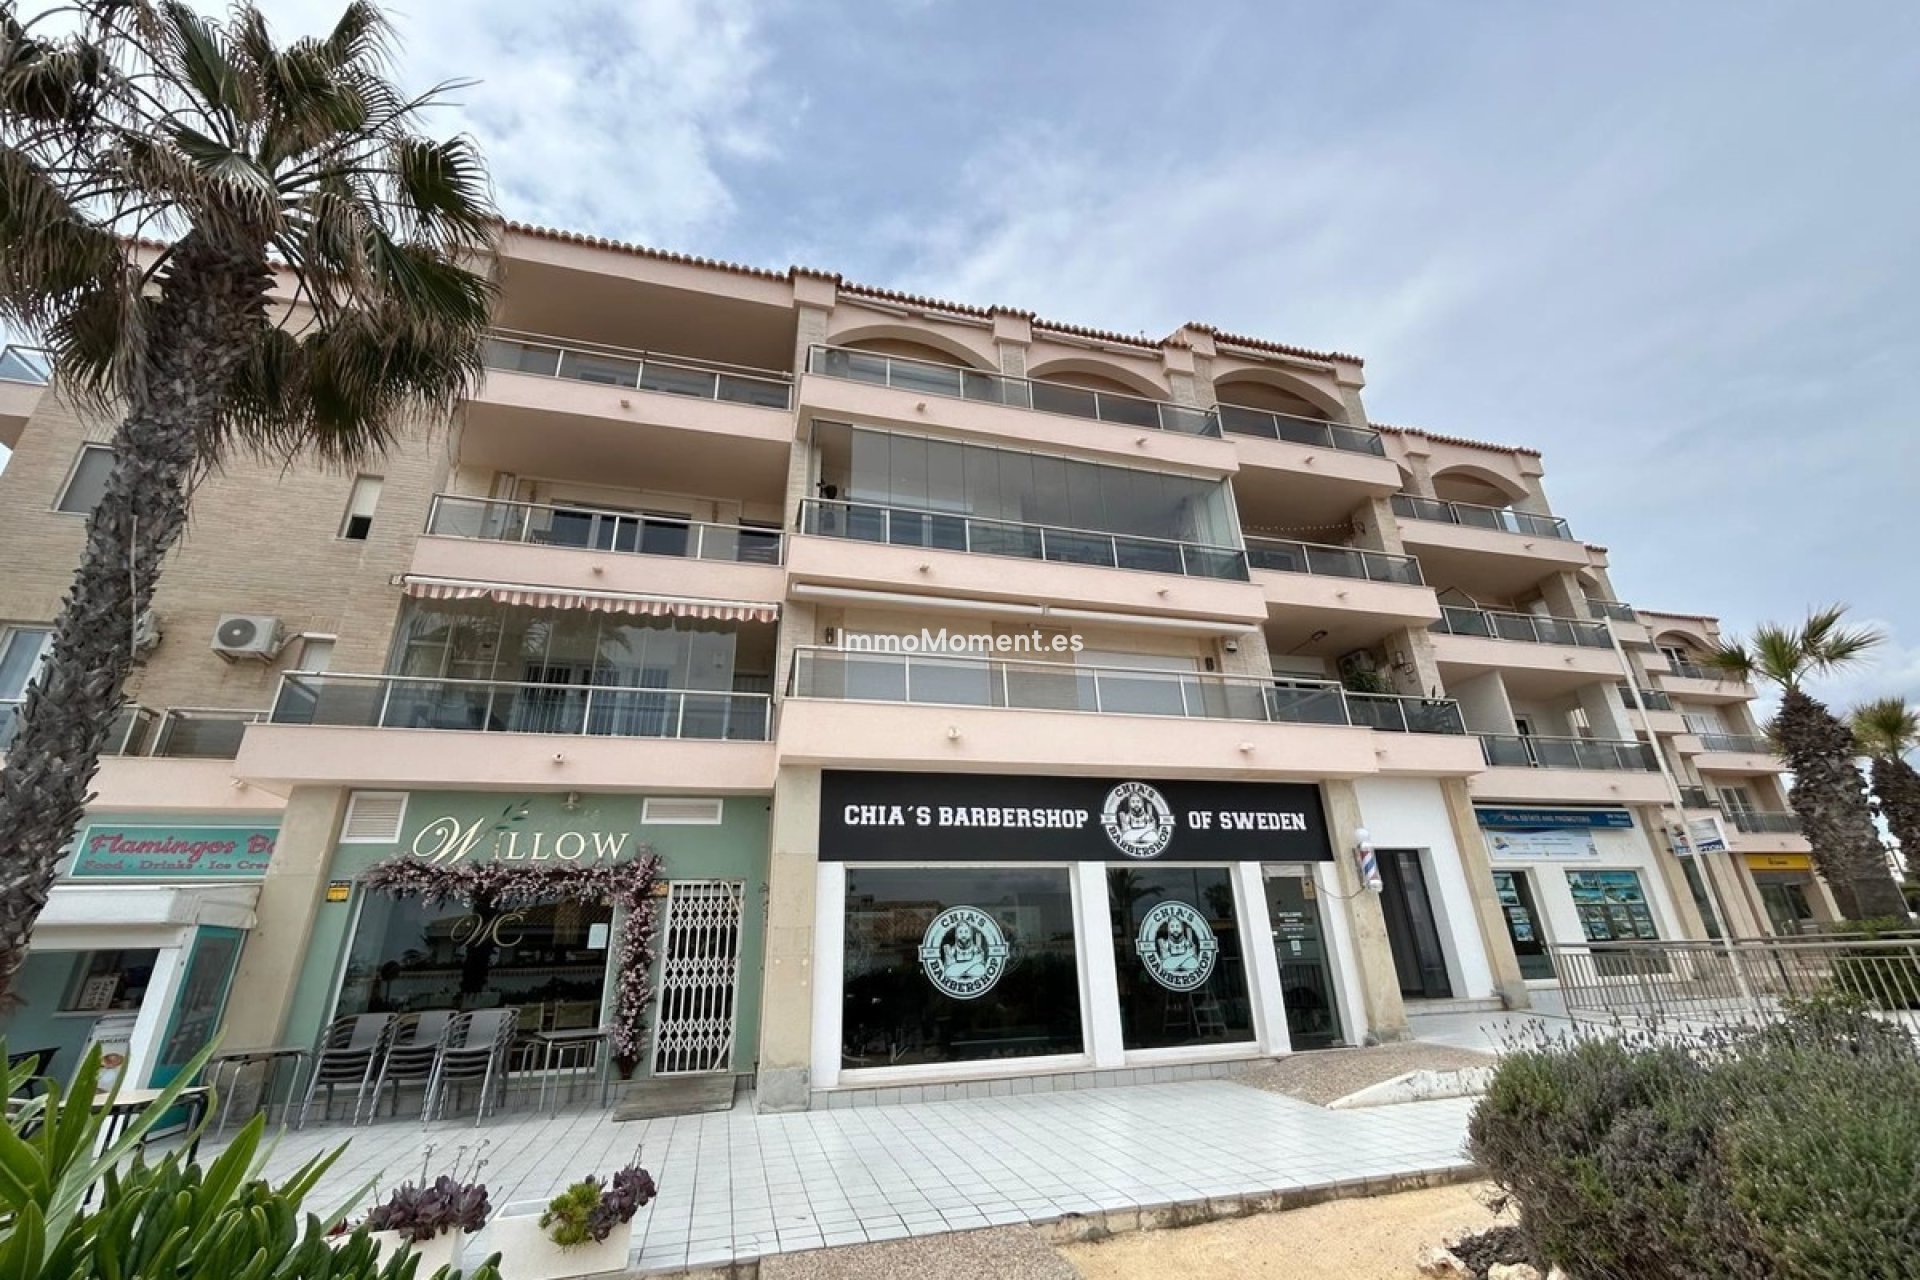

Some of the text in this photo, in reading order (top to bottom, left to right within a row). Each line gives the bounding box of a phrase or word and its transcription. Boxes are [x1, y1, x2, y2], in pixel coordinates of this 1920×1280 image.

[938, 807, 1089, 828] BARBERSHOP
[1188, 811, 1212, 829] OF
[1219, 812, 1307, 830] SWEDEN
[89, 833, 237, 863] Flamingos
[83, 860, 123, 870] Food
[138, 860, 193, 870] Drinks
[940, 911, 986, 928] CHIA'S
[1153, 906, 1195, 922] CHIA'S
[929, 957, 999, 993] BARBERSHOP
[1146, 951, 1210, 985] BARBERSHOP
